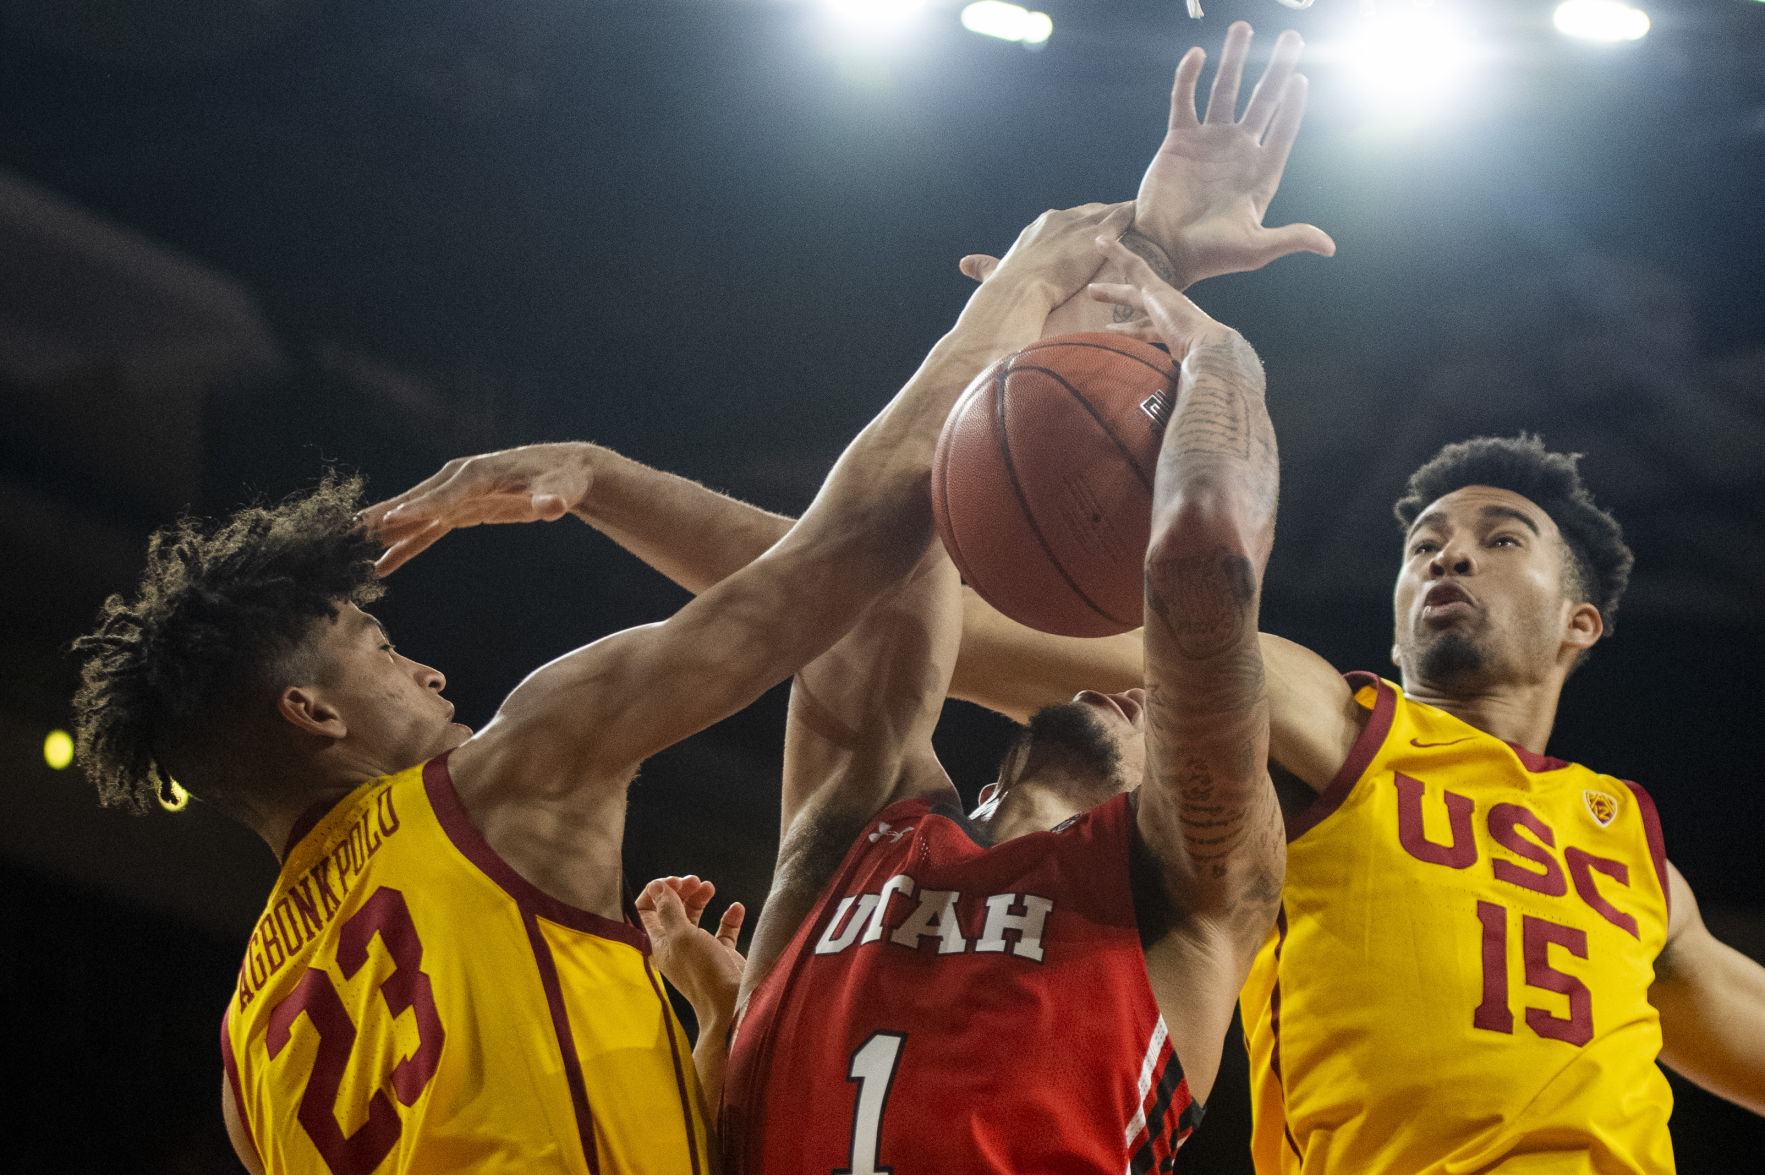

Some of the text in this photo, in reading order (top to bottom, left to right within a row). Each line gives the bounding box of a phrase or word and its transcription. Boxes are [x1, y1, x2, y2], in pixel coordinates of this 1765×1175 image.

[239, 786, 400, 1014] AGBONKPOLO
[1394, 771, 1641, 942] USC
[265, 886, 446, 1175] 23
[1473, 900, 1594, 1048] 15
[832, 1029, 908, 1175] 1
